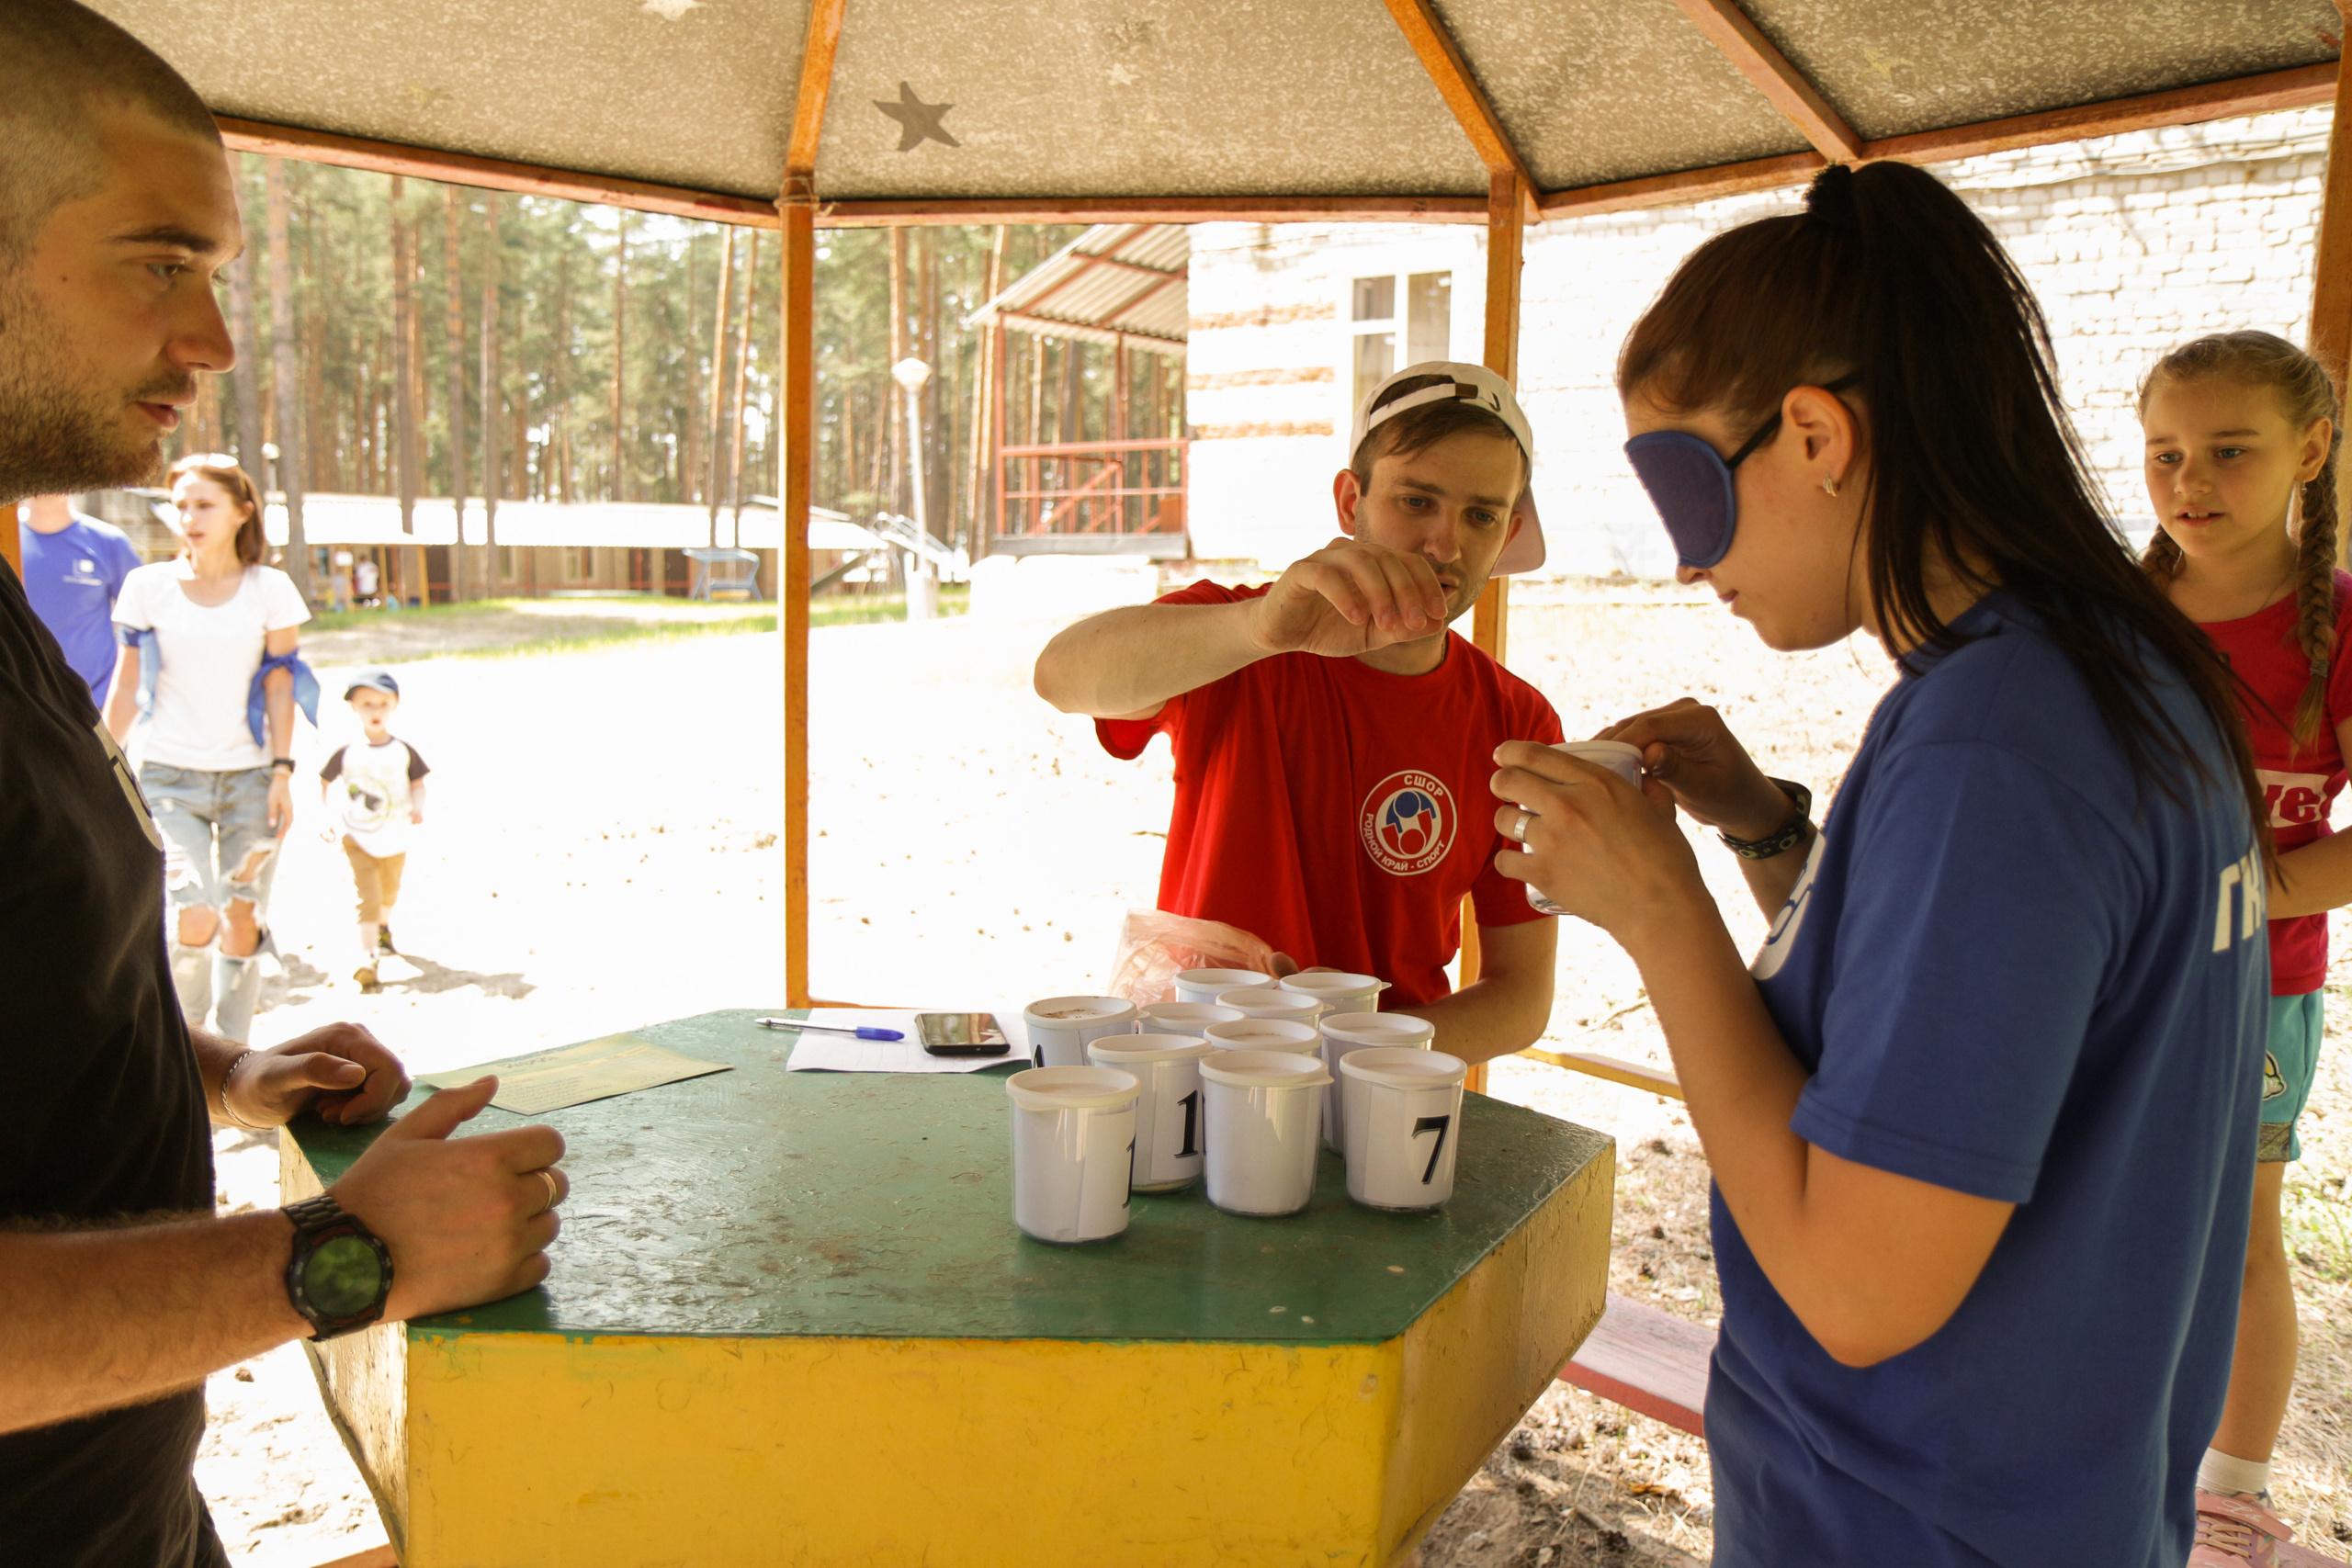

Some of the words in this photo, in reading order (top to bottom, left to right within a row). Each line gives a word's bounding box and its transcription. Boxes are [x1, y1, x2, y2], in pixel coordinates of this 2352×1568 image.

[1403, 774, 1444, 796] СШОР
[1363, 813, 1383, 859] РОДНОЙ
[1381, 855, 1408, 871] КРАЙ
[1416, 840, 1445, 869] СПОРТ
[1411, 1114, 1451, 1184] 7
